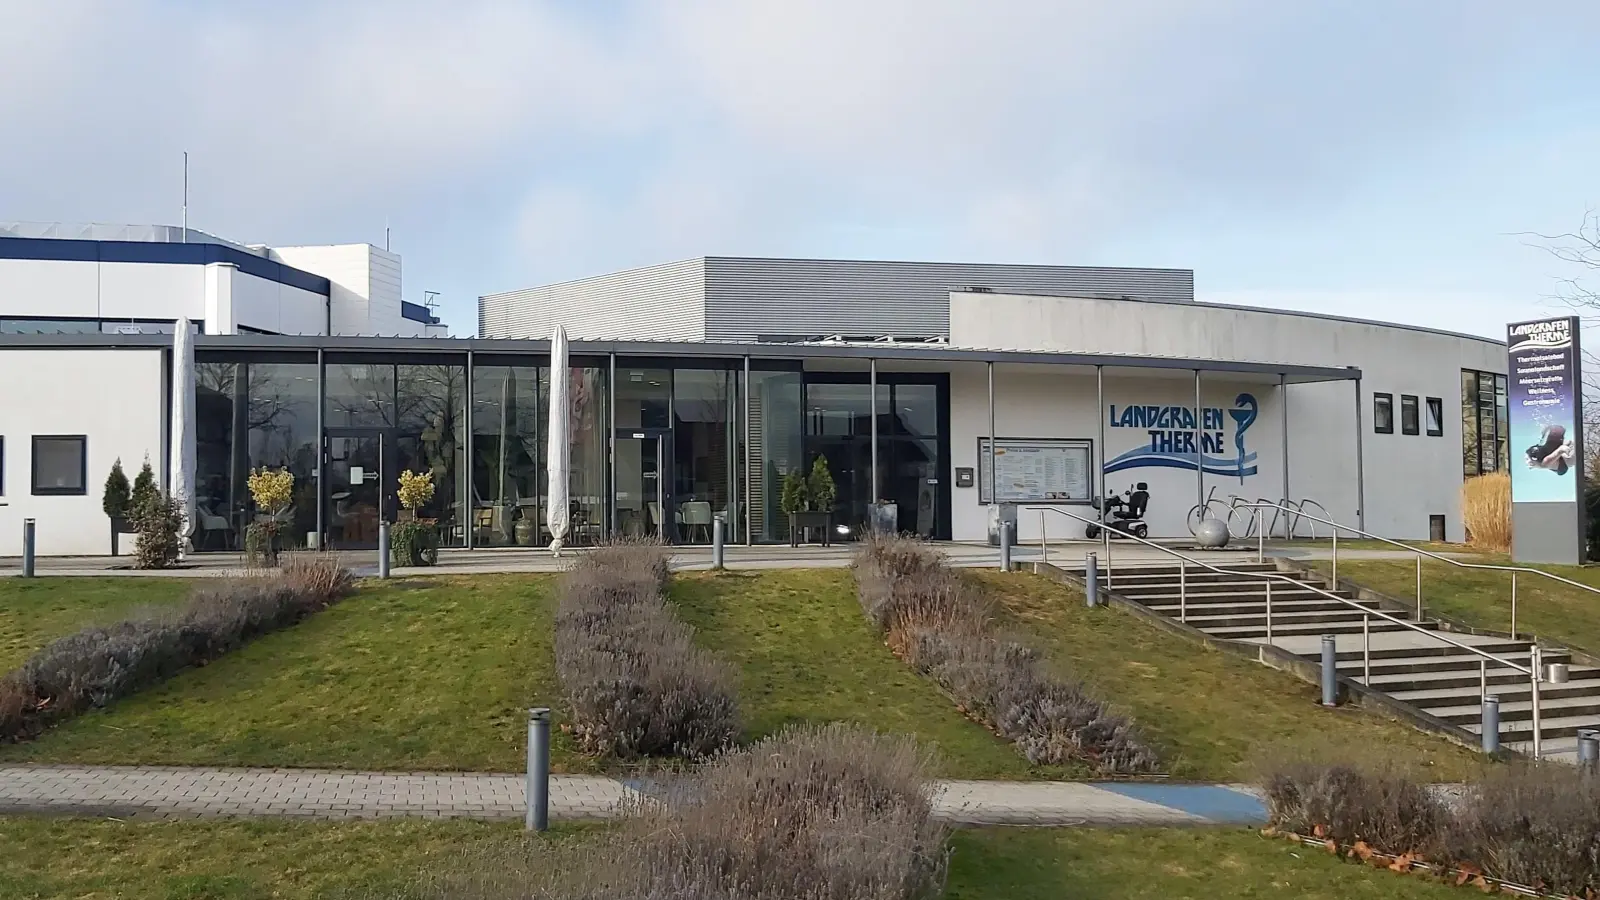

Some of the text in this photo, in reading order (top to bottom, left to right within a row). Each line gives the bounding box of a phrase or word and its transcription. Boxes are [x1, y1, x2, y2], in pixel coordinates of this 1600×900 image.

[1510, 320, 1569, 336] LANDGRAFEN
[1528, 330, 1569, 342] THERME
[1523, 398, 1560, 406] Gastronomie
[1148, 430, 1224, 454] THERME
